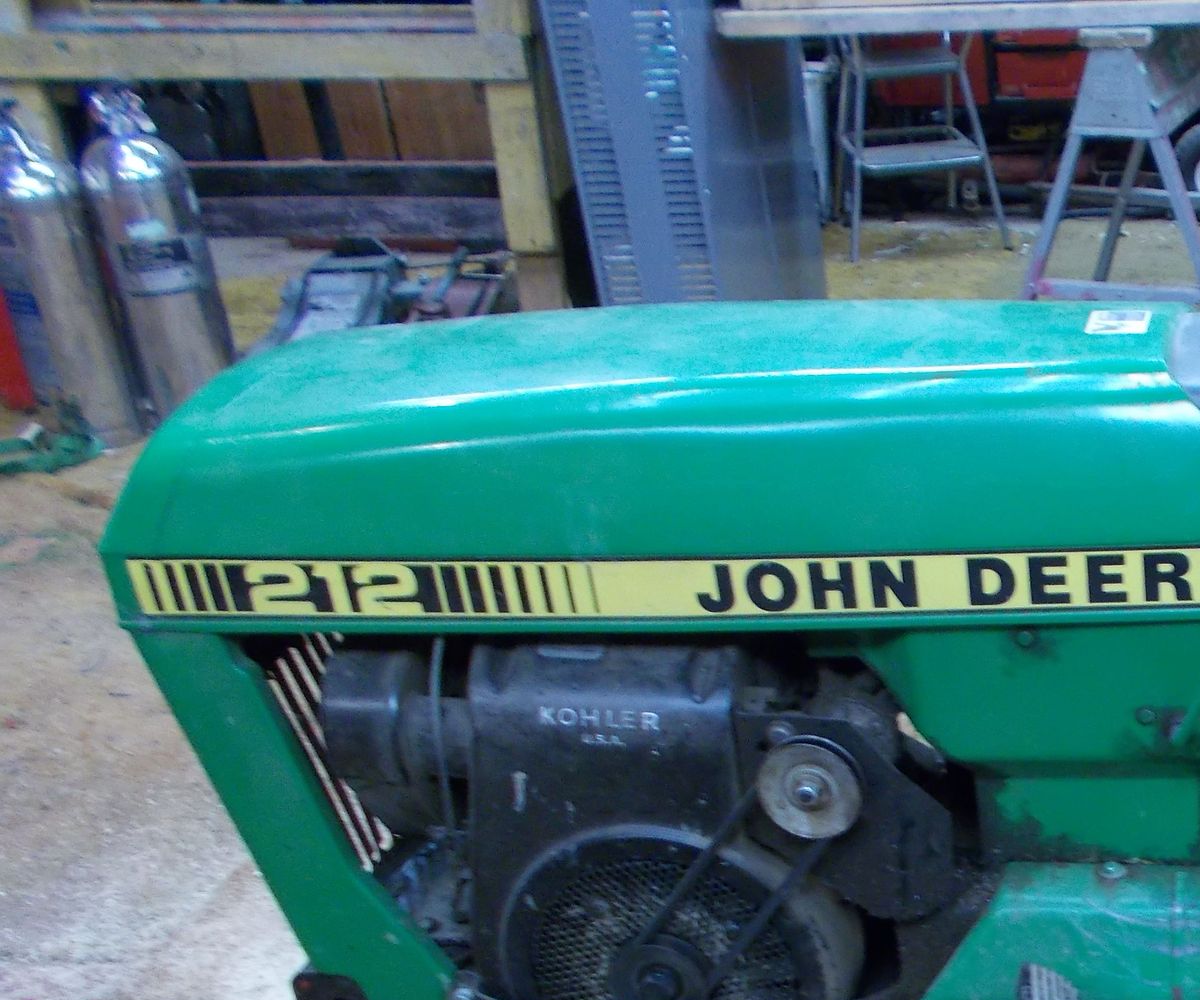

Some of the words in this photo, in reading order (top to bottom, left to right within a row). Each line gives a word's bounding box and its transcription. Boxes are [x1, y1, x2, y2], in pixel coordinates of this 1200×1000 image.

[246, 563, 424, 613] 212
[696, 560, 919, 612] JOHN
[538, 705, 661, 732] KOHLER
